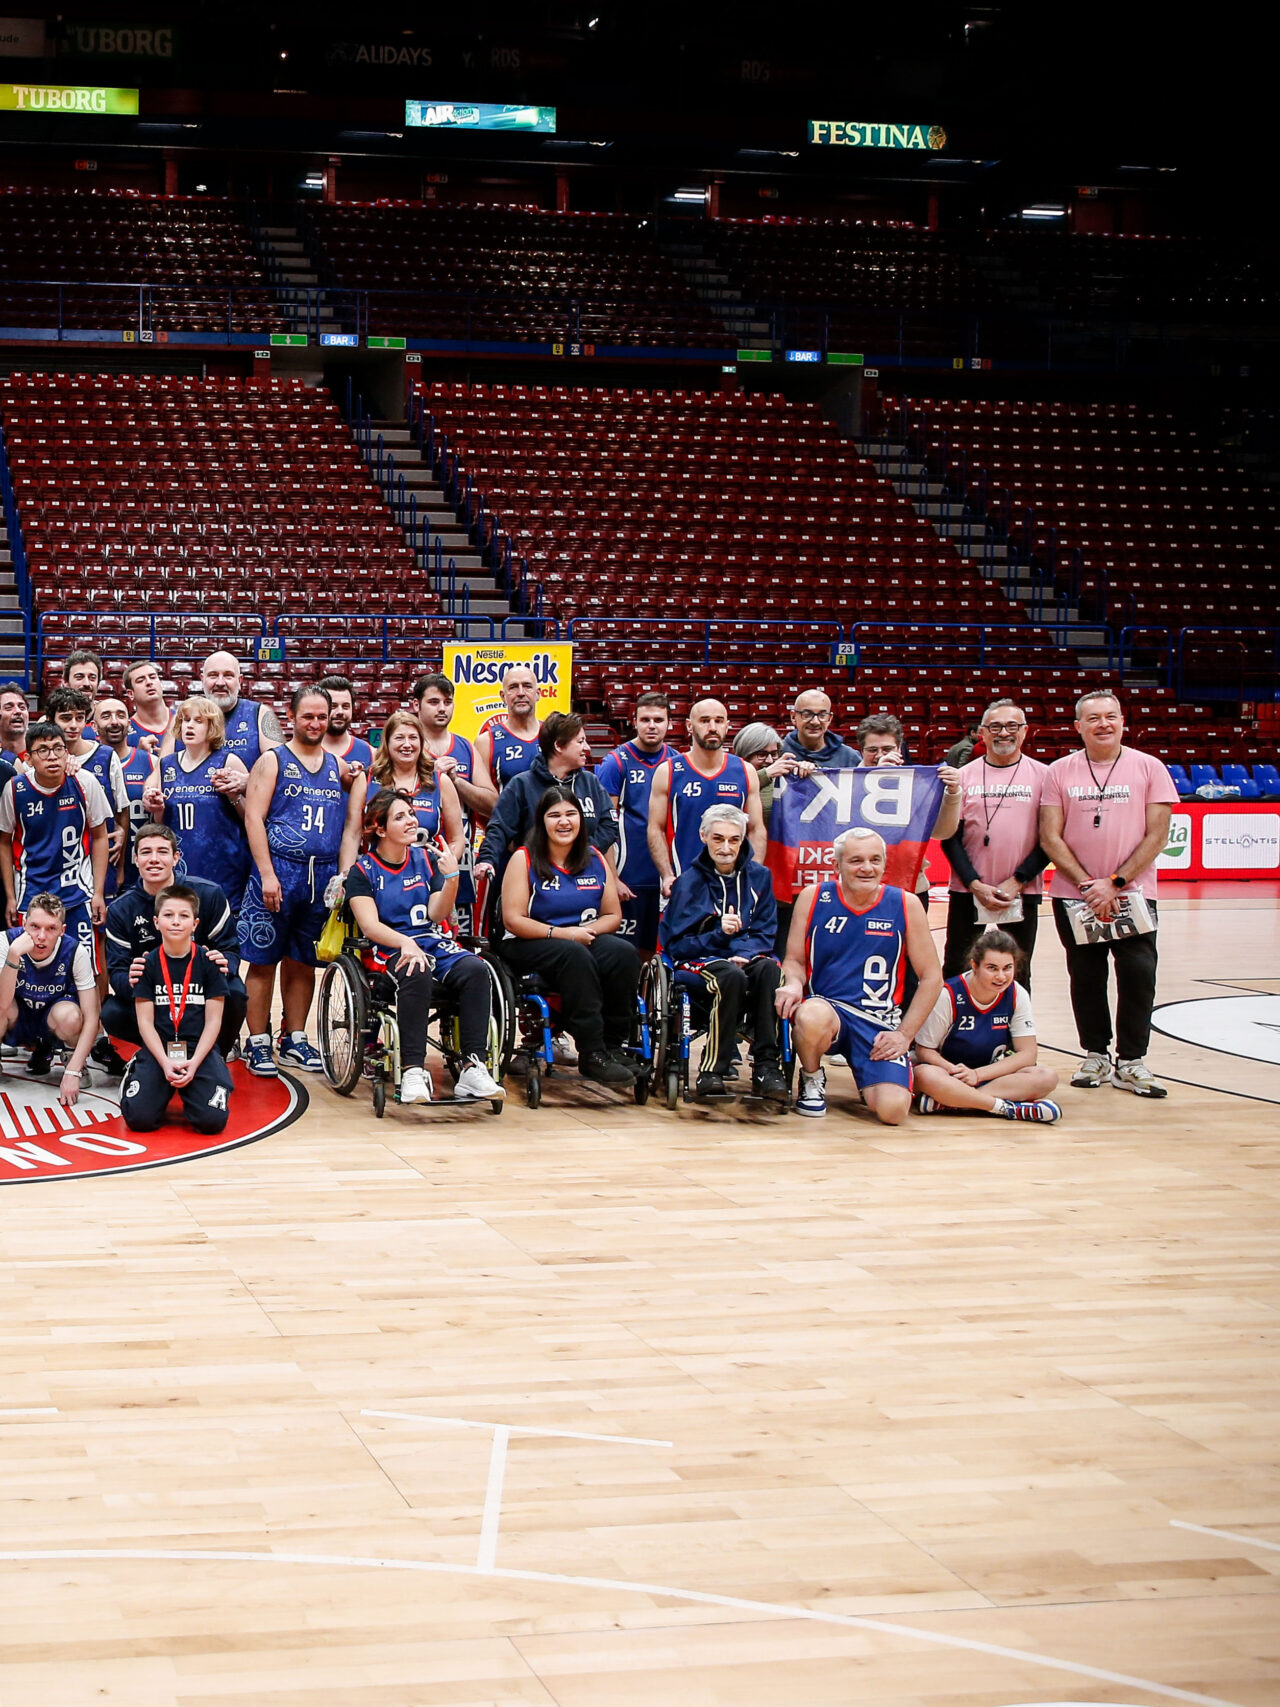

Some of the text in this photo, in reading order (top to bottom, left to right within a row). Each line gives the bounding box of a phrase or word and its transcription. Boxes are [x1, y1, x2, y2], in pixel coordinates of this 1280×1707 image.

[356, 44, 433, 66] ALIDAYS
[12, 86, 106, 112] TUBORG
[811, 120, 926, 150] FESTINA
[142, 332, 152, 341] 22
[330, 335, 348, 345] BAR
[794, 352, 812, 362] BAR
[263, 639, 277, 647] 22
[840, 645, 853, 653] 23
[454, 654, 558, 684] Nesik
[486, 702, 508, 710] mere
[505, 746, 524, 761] 52
[630, 770, 646, 784] 32
[174, 783, 218, 797] energo
[303, 785, 341, 800] energon
[682, 781, 702, 797] 45
[718, 783, 738, 793] BKP
[27, 800, 44, 817] 34
[59, 797, 75, 807] BKP
[412, 799, 432, 808] BKP
[177, 803, 194, 831] 10
[301, 805, 325, 834] 34
[1205, 834, 1278, 848] STELLANTIS
[61, 825, 81, 888] BKP
[403, 874, 423, 886] BKP
[576, 876, 597, 887] BKP
[616, 918, 637, 935] 32
[824, 916, 848, 934] 47
[867, 921, 892, 931] BKP
[958, 1016, 975, 1031] 23
[209, 1086, 227, 1111] A
